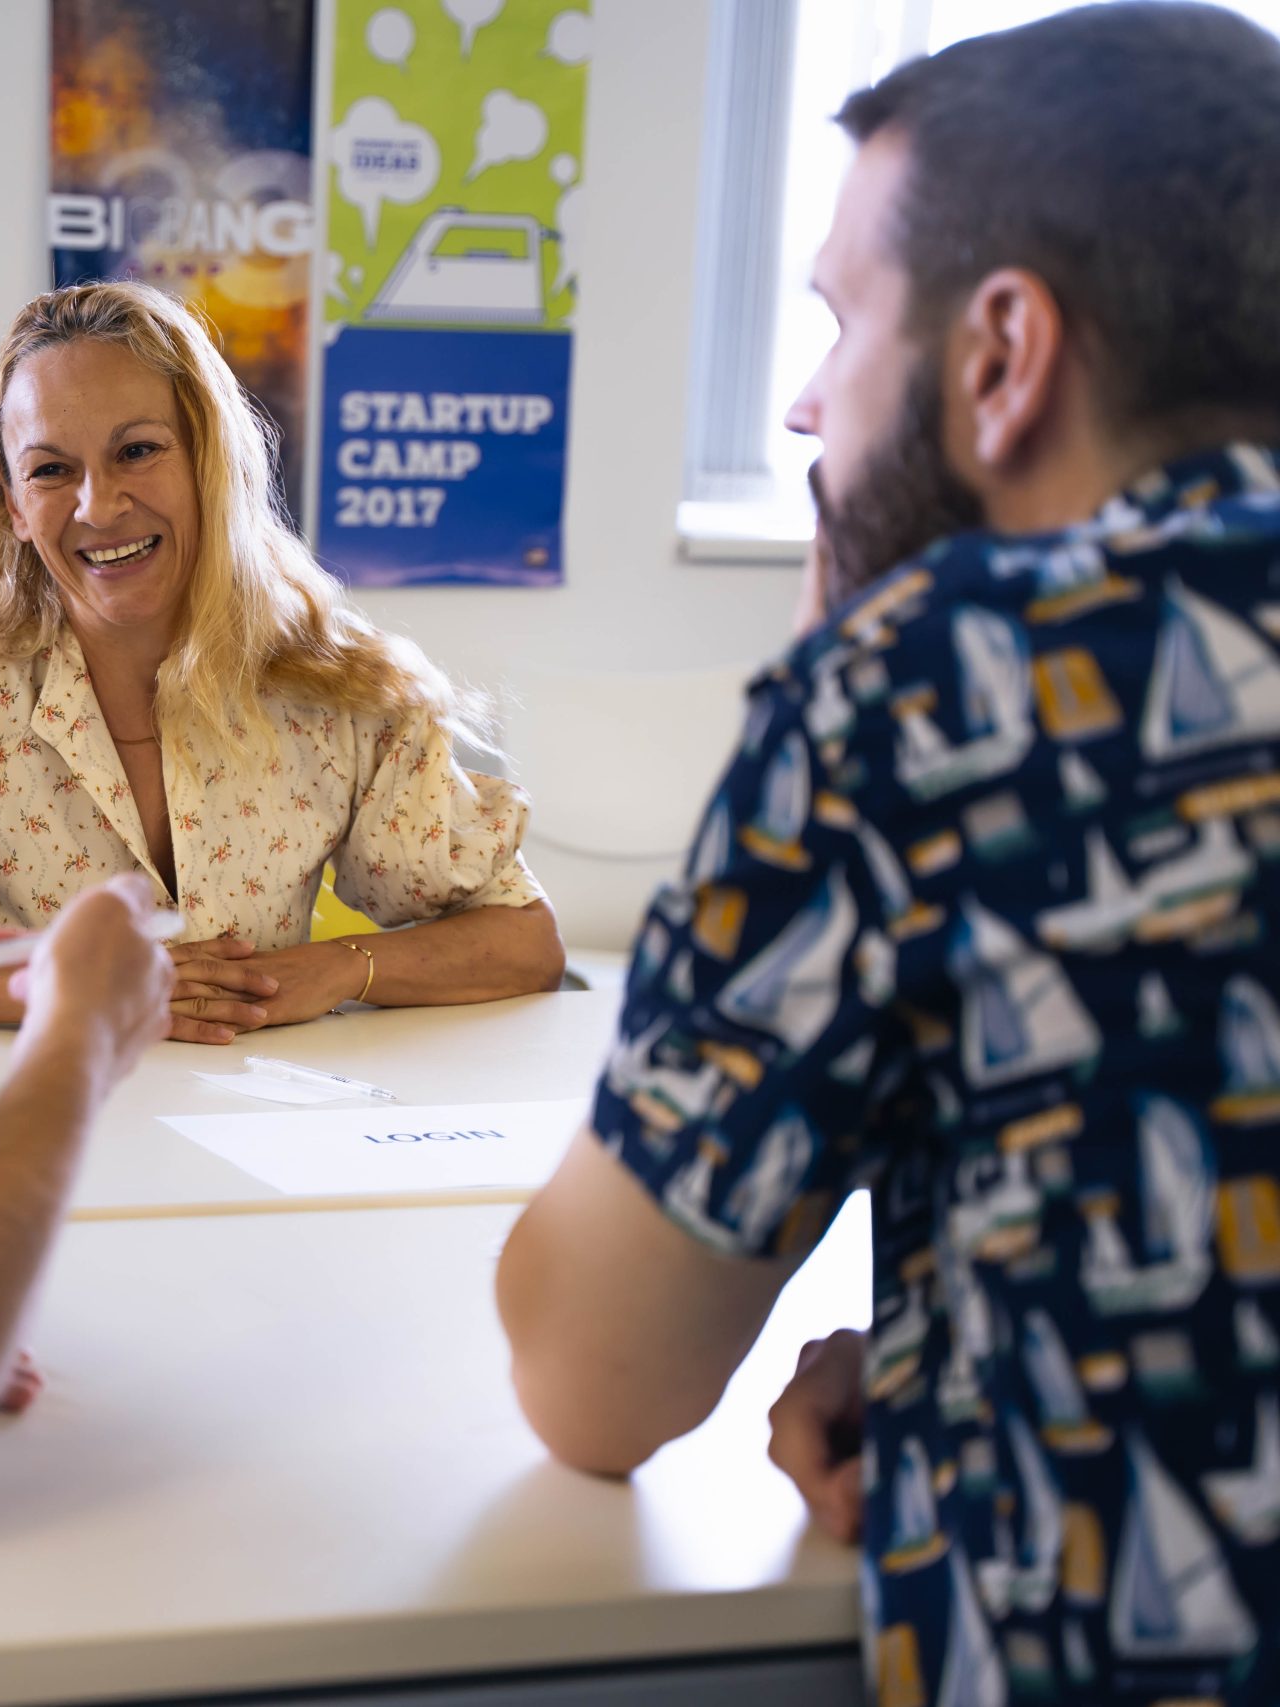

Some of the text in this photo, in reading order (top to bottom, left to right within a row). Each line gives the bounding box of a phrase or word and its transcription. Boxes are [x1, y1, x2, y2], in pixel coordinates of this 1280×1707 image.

[339, 391, 552, 433] STARTUP
[337, 439, 481, 480] CAMP
[335, 487, 446, 527] 2017
[363, 1130, 506, 1144] LOGIN
